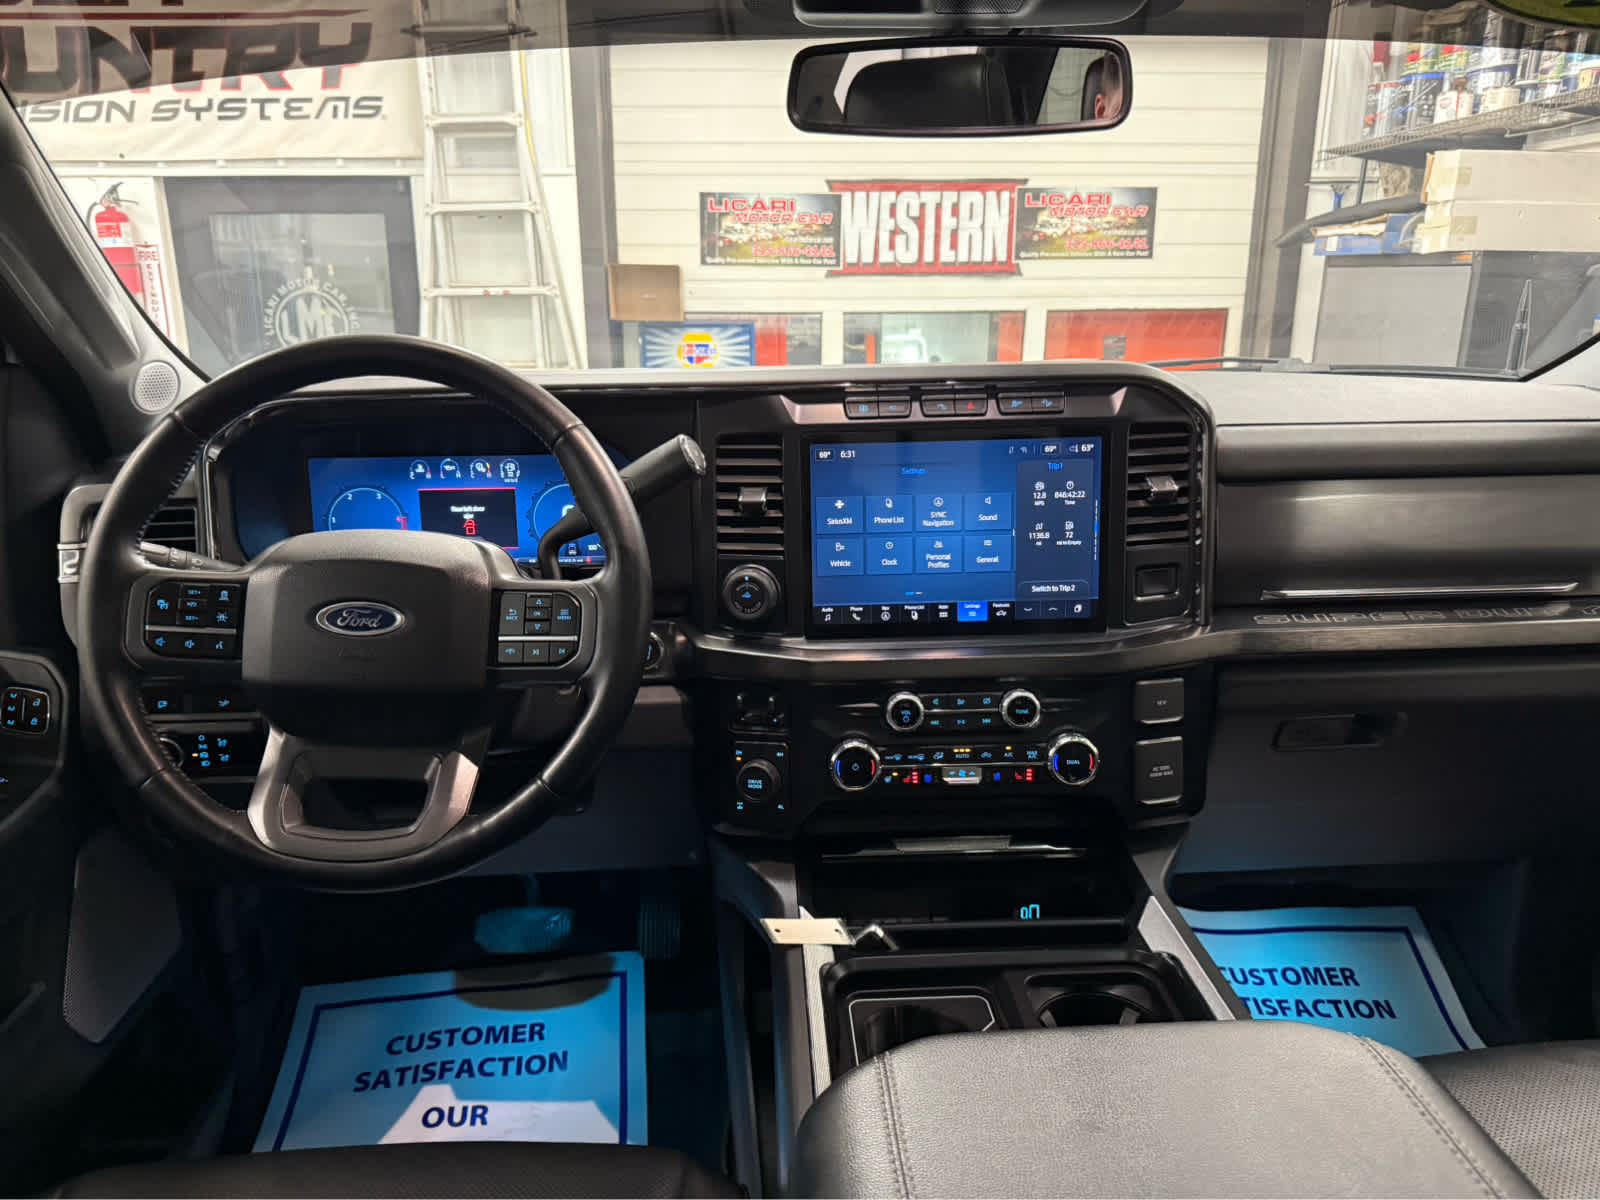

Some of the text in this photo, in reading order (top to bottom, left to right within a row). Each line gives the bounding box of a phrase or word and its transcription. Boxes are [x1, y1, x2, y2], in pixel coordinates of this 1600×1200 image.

[0, 22, 373, 94] UNTRY
[151, 95, 385, 122] SYSTEMS
[708, 198, 796, 213] LICARI
[1025, 192, 1112, 208] LICARI
[1049, 205, 1149, 218] MOTOR CAR
[733, 212, 833, 225] MOTOR CAR
[841, 189, 1010, 264] WESTERN
[840, 449, 856, 459] 6:31
[874, 516, 905, 524] Phone List
[930, 511, 948, 519] SYNC
[978, 513, 999, 521] Sound
[922, 519, 955, 528] Navigation
[829, 559, 852, 568] Vehicle
[881, 558, 898, 566] Clock
[925, 553, 952, 561] Personal
[976, 555, 1000, 563] General
[927, 561, 951, 569] Profiles
[1031, 584, 1052, 593] Switch
[1059, 583, 1071, 593] Trip
[337, 608, 383, 628] Ford
[1065, 758, 1081, 766] DUAL
[1218, 966, 1361, 987] USTOMER
[1240, 997, 1398, 1020] TISFACTION
[385, 1021, 546, 1056] CUSTOMER
[352, 1050, 569, 1093] SATISFACTION
[421, 1104, 490, 1129] OUR
